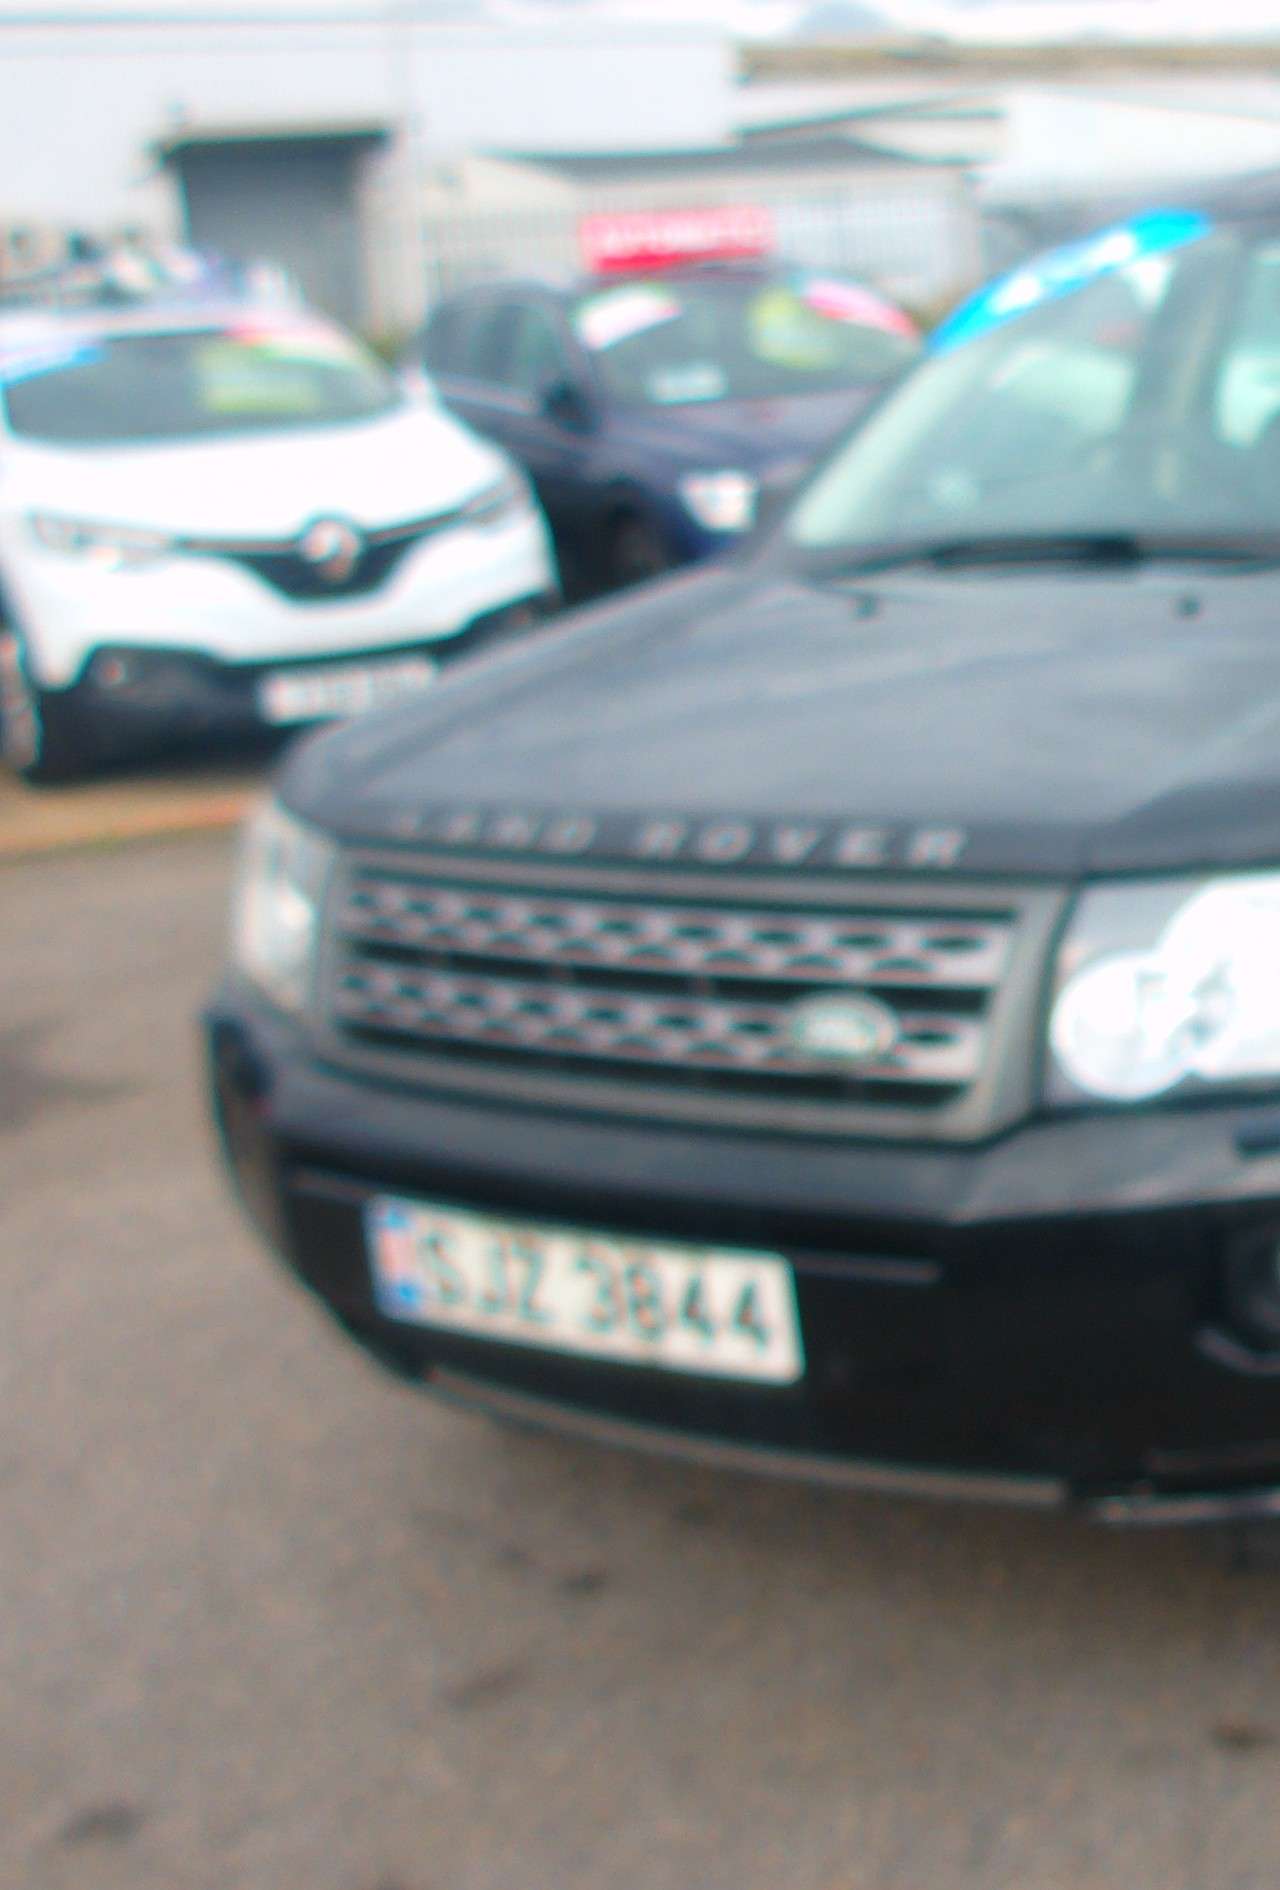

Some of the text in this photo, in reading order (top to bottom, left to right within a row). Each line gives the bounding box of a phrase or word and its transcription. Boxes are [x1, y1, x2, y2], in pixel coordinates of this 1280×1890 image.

[392, 810, 968, 868] LAND ROVER
[420, 1226, 772, 1356] SJZ 3844
